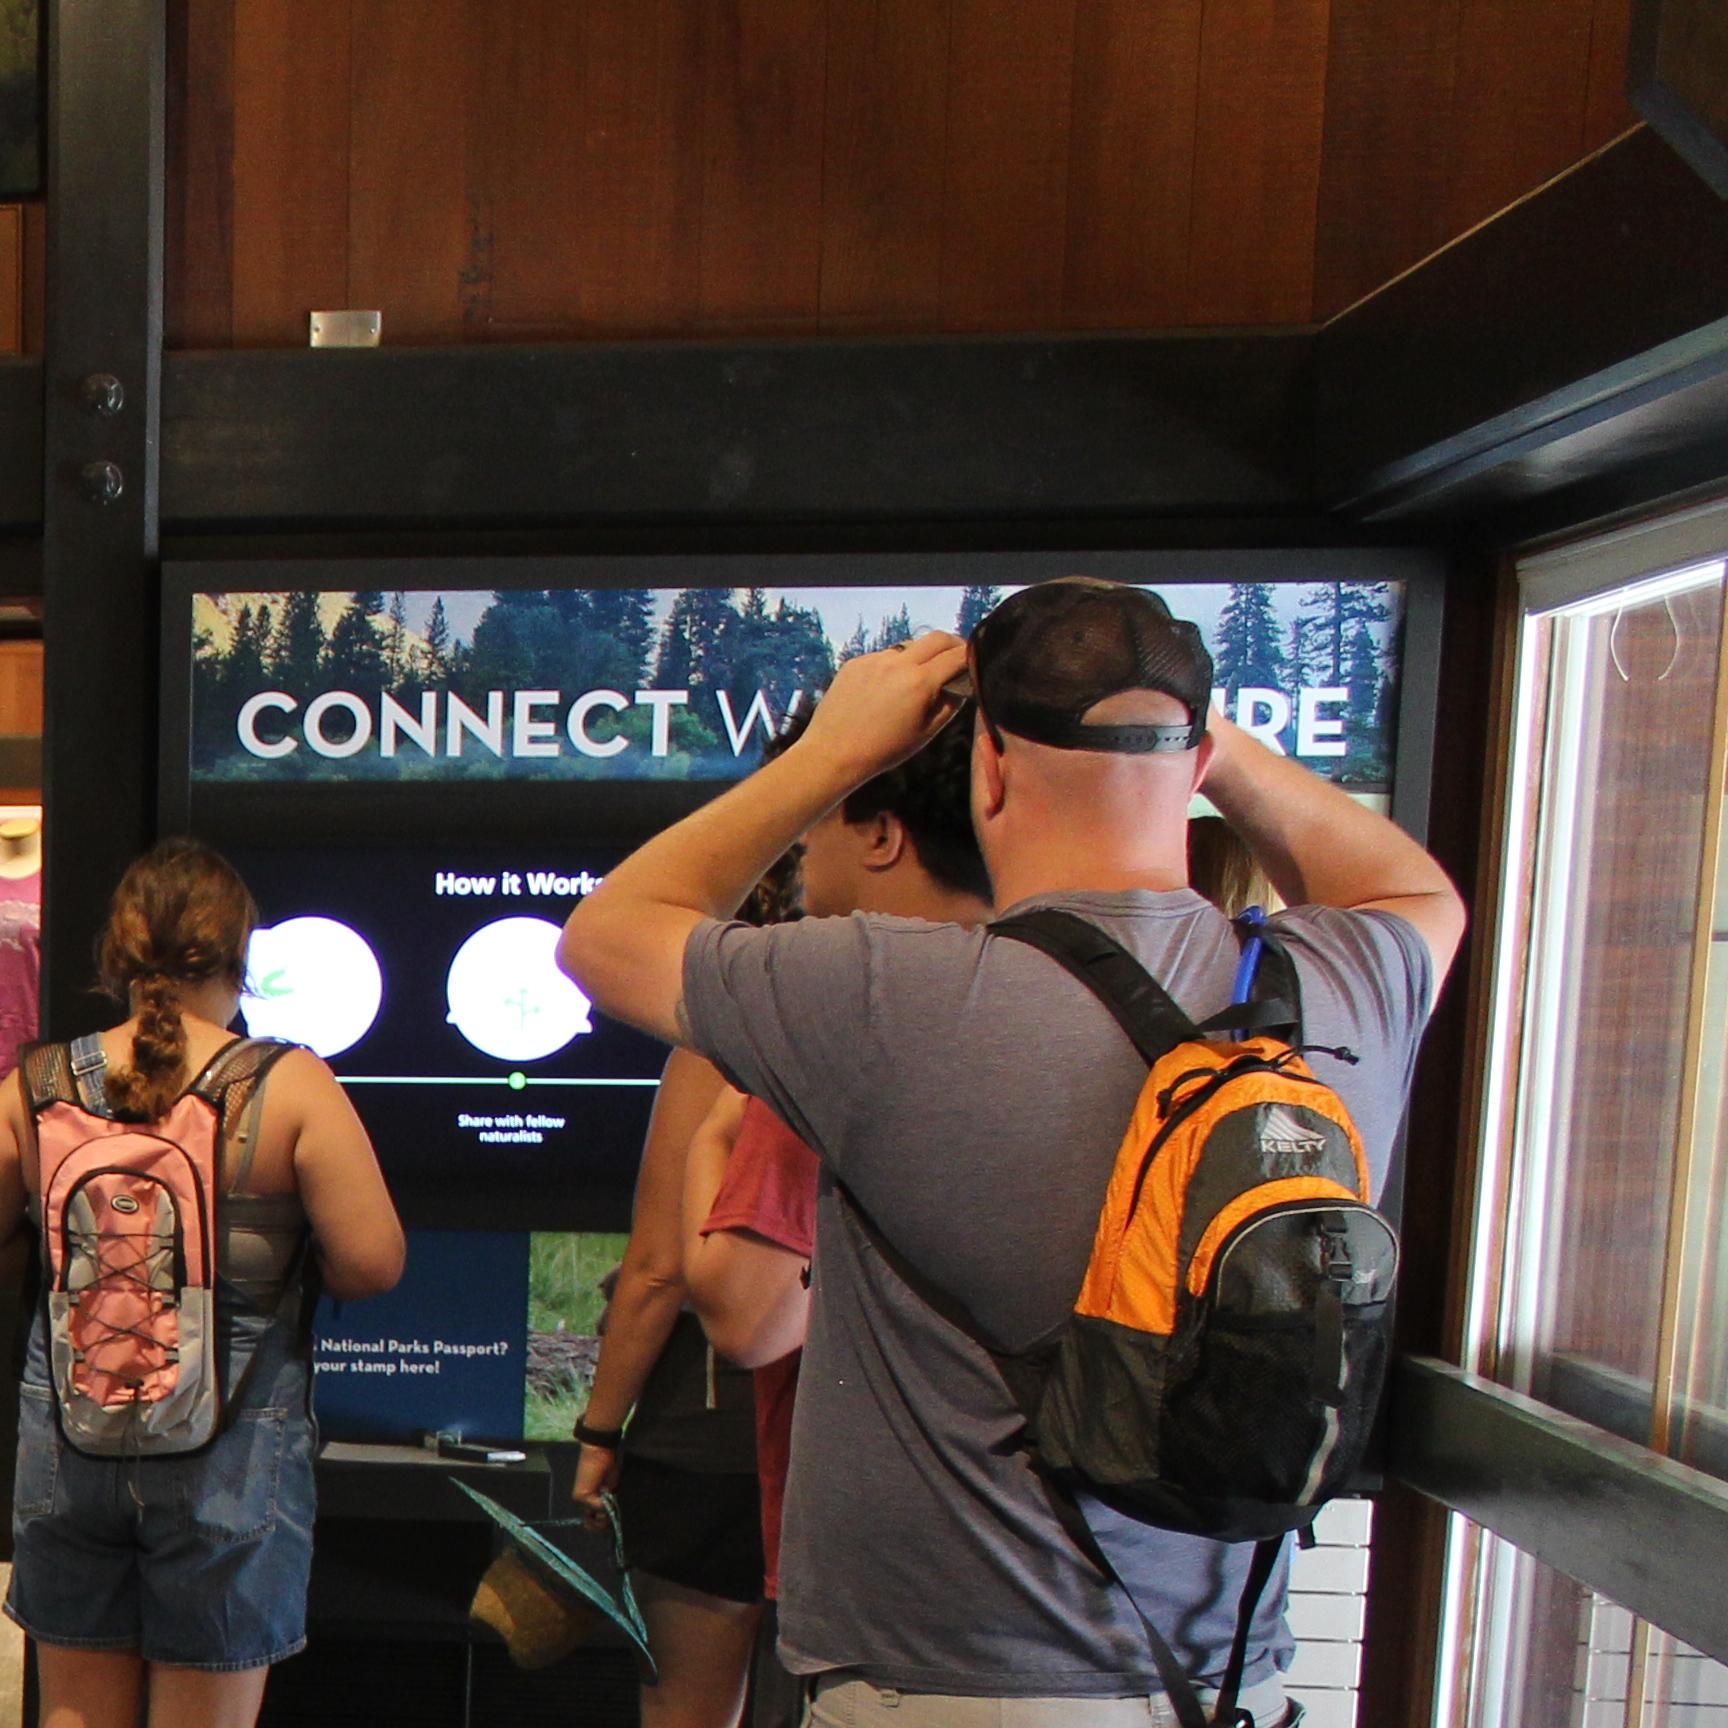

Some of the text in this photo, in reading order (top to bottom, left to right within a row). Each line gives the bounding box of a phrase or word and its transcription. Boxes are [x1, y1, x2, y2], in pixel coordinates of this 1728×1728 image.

[237, 690, 689, 760] CONNECT
[434, 872, 495, 896] How
[502, 871, 522, 896] it
[458, 1113, 565, 1129] Share with fellow
[479, 1130, 543, 1144] naturalists
[1261, 1137, 1328, 1154] KELTY
[321, 1338, 509, 1358] National Parks Passport?
[313, 1358, 440, 1376] your stamp here!
